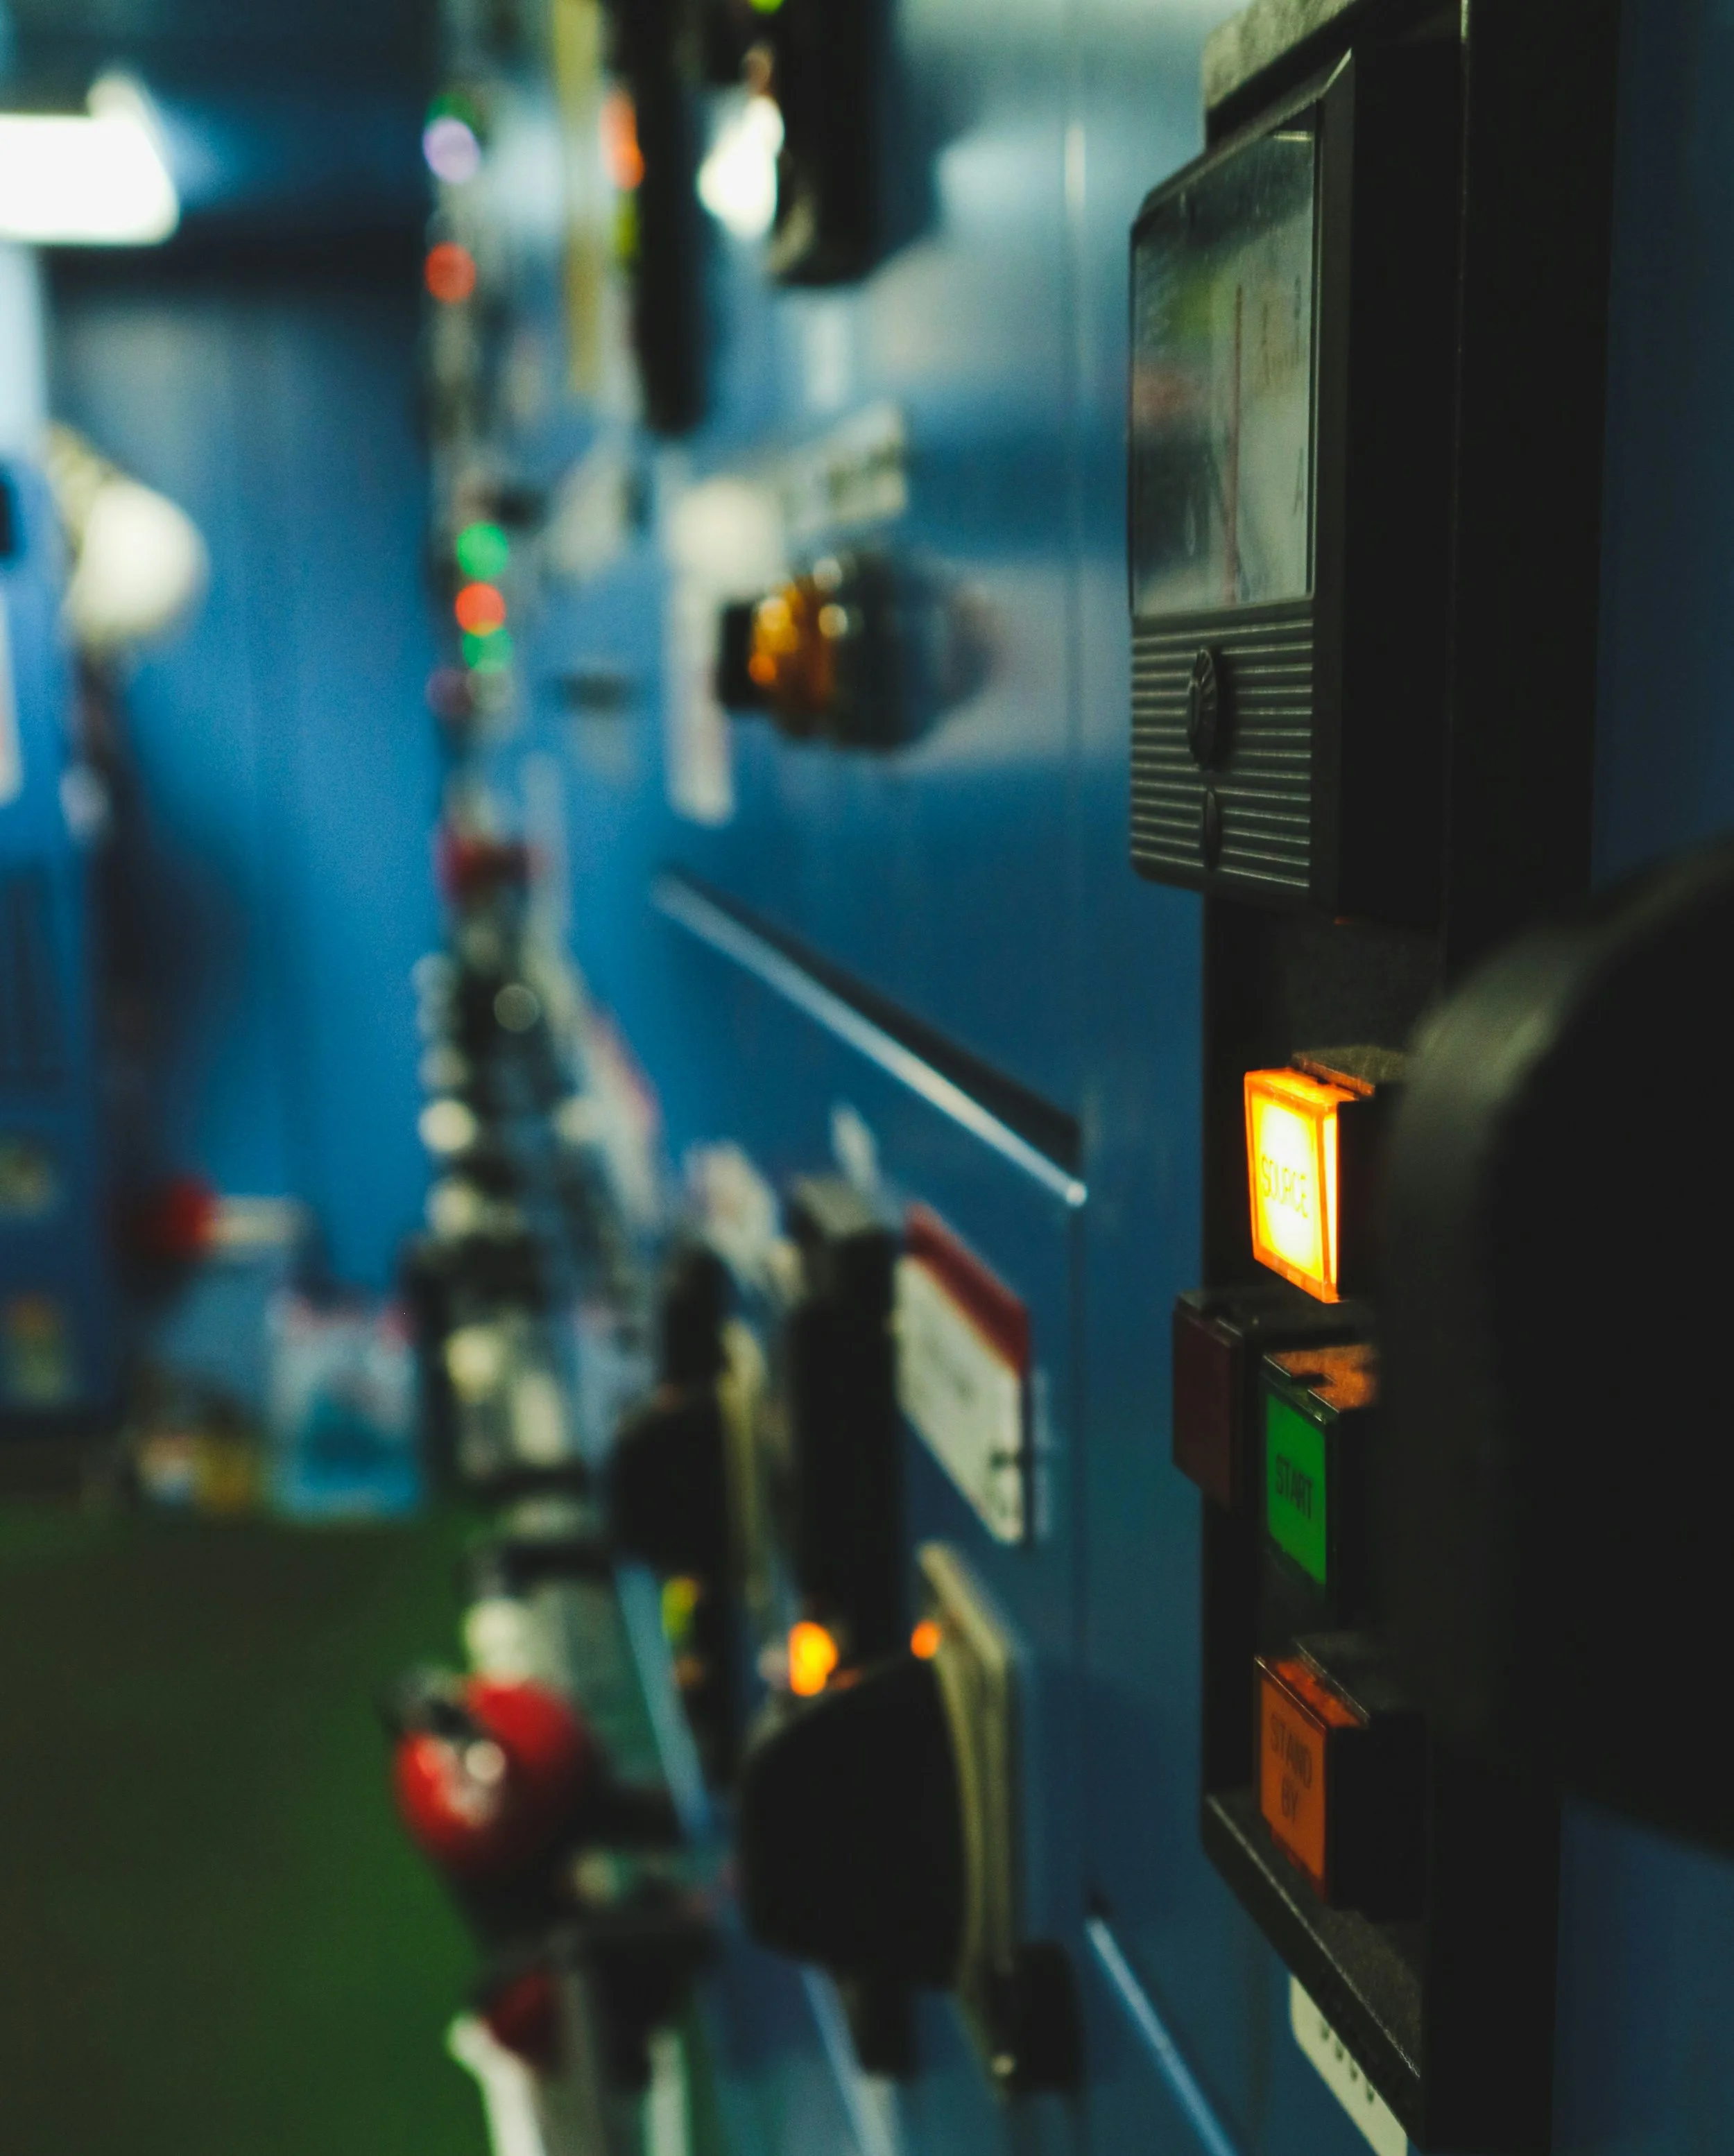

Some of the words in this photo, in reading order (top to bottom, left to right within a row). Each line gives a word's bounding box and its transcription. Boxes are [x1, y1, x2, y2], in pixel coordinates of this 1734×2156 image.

[1261, 1155, 1307, 1218] SOURCE
[1276, 1453, 1312, 1519] START
[1271, 1711, 1312, 1790] STAND
[1281, 1773, 1299, 1824] BY
